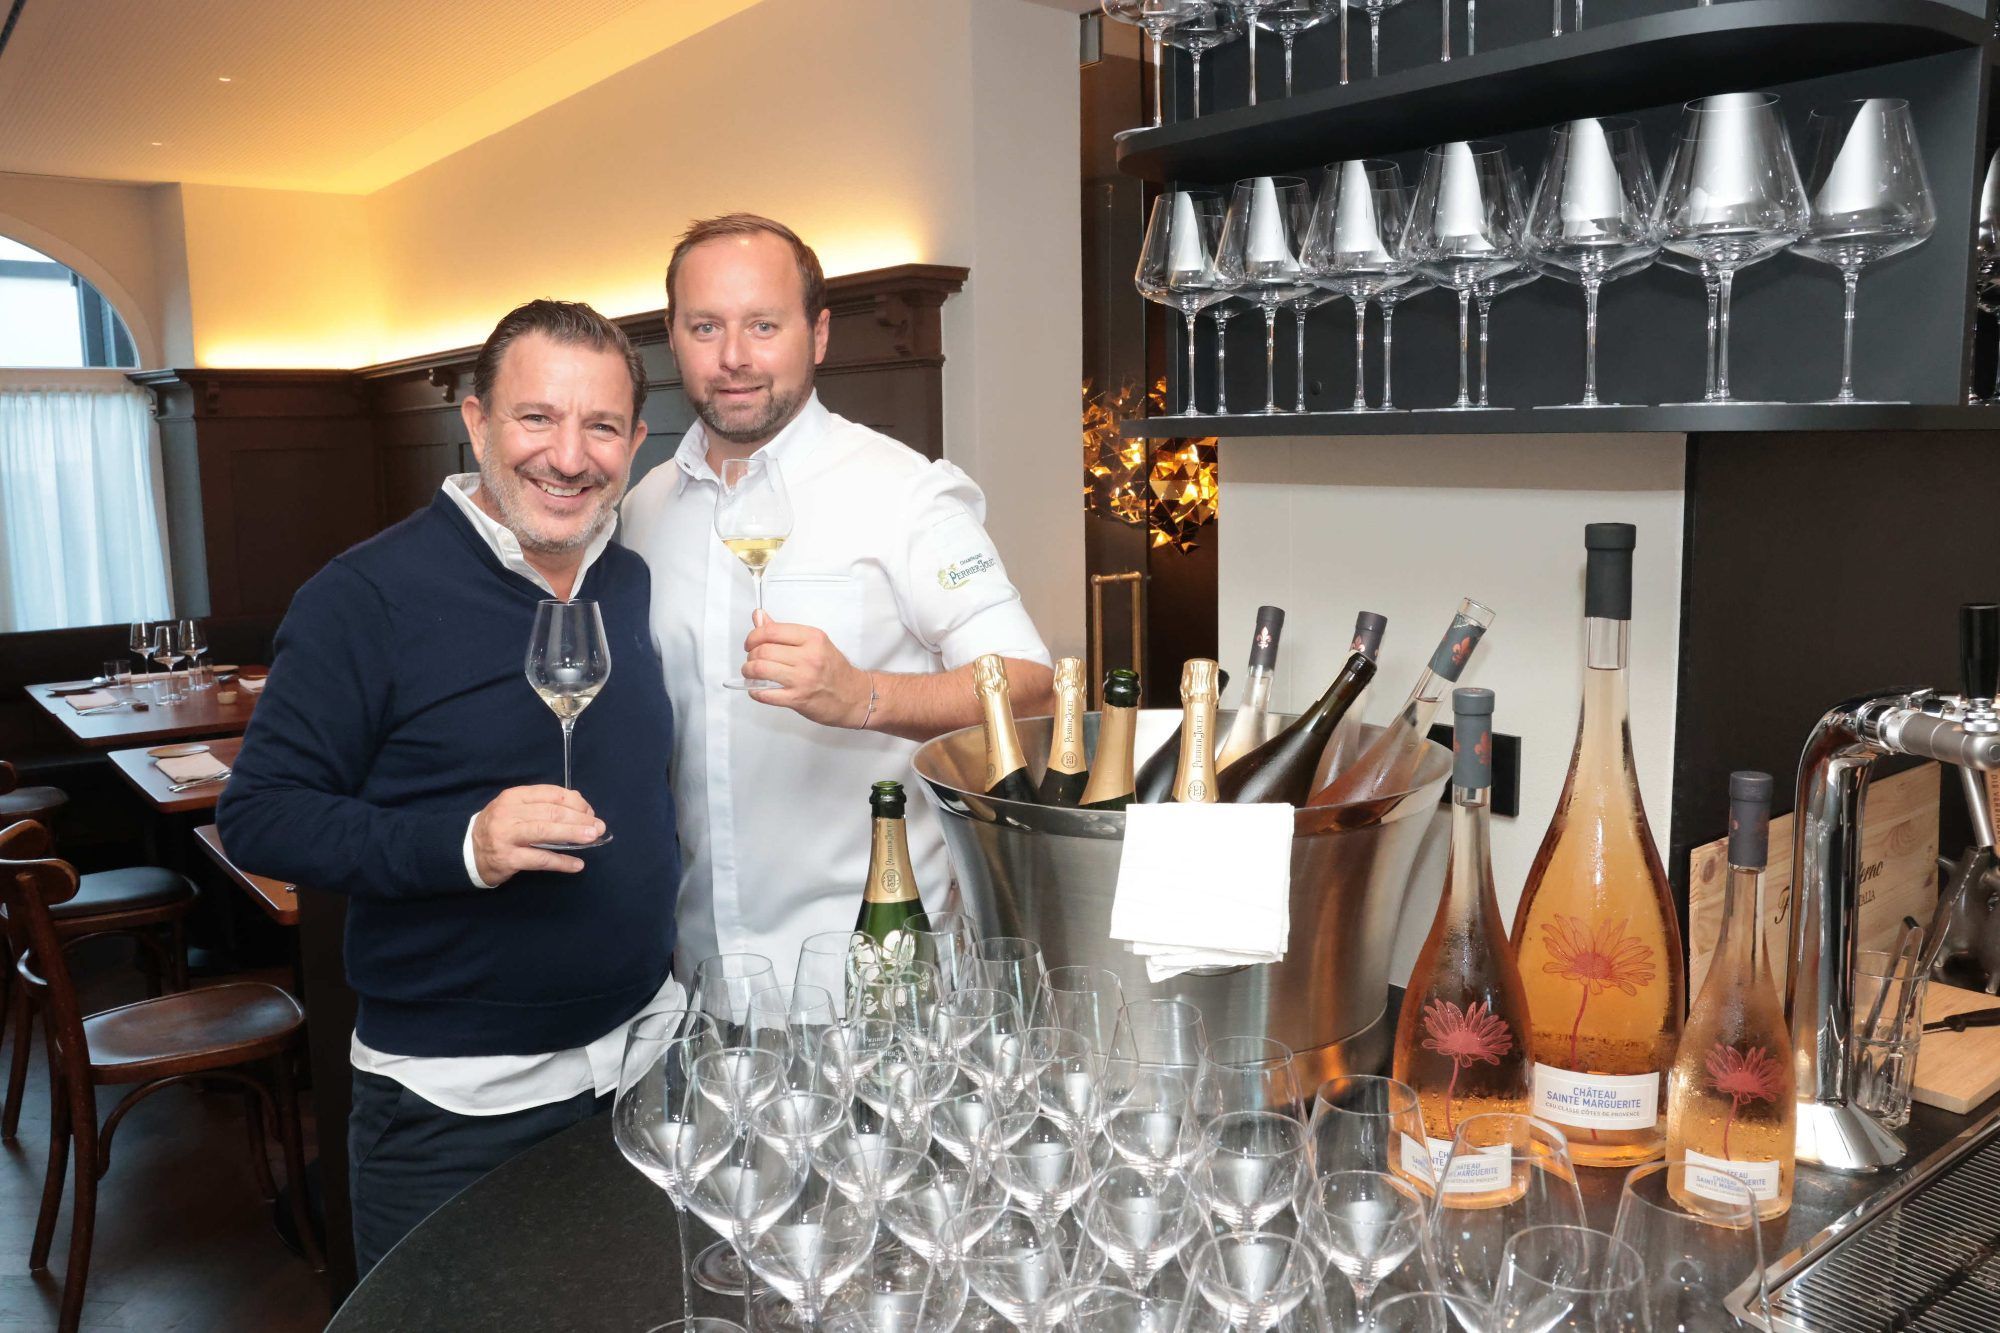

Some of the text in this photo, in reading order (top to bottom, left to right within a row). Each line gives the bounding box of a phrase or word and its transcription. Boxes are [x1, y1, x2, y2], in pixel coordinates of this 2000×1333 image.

[1547, 1091, 1641, 1109] SAINTE MARGUERITE
[1573, 1087, 1617, 1099] CHÂTEAU
